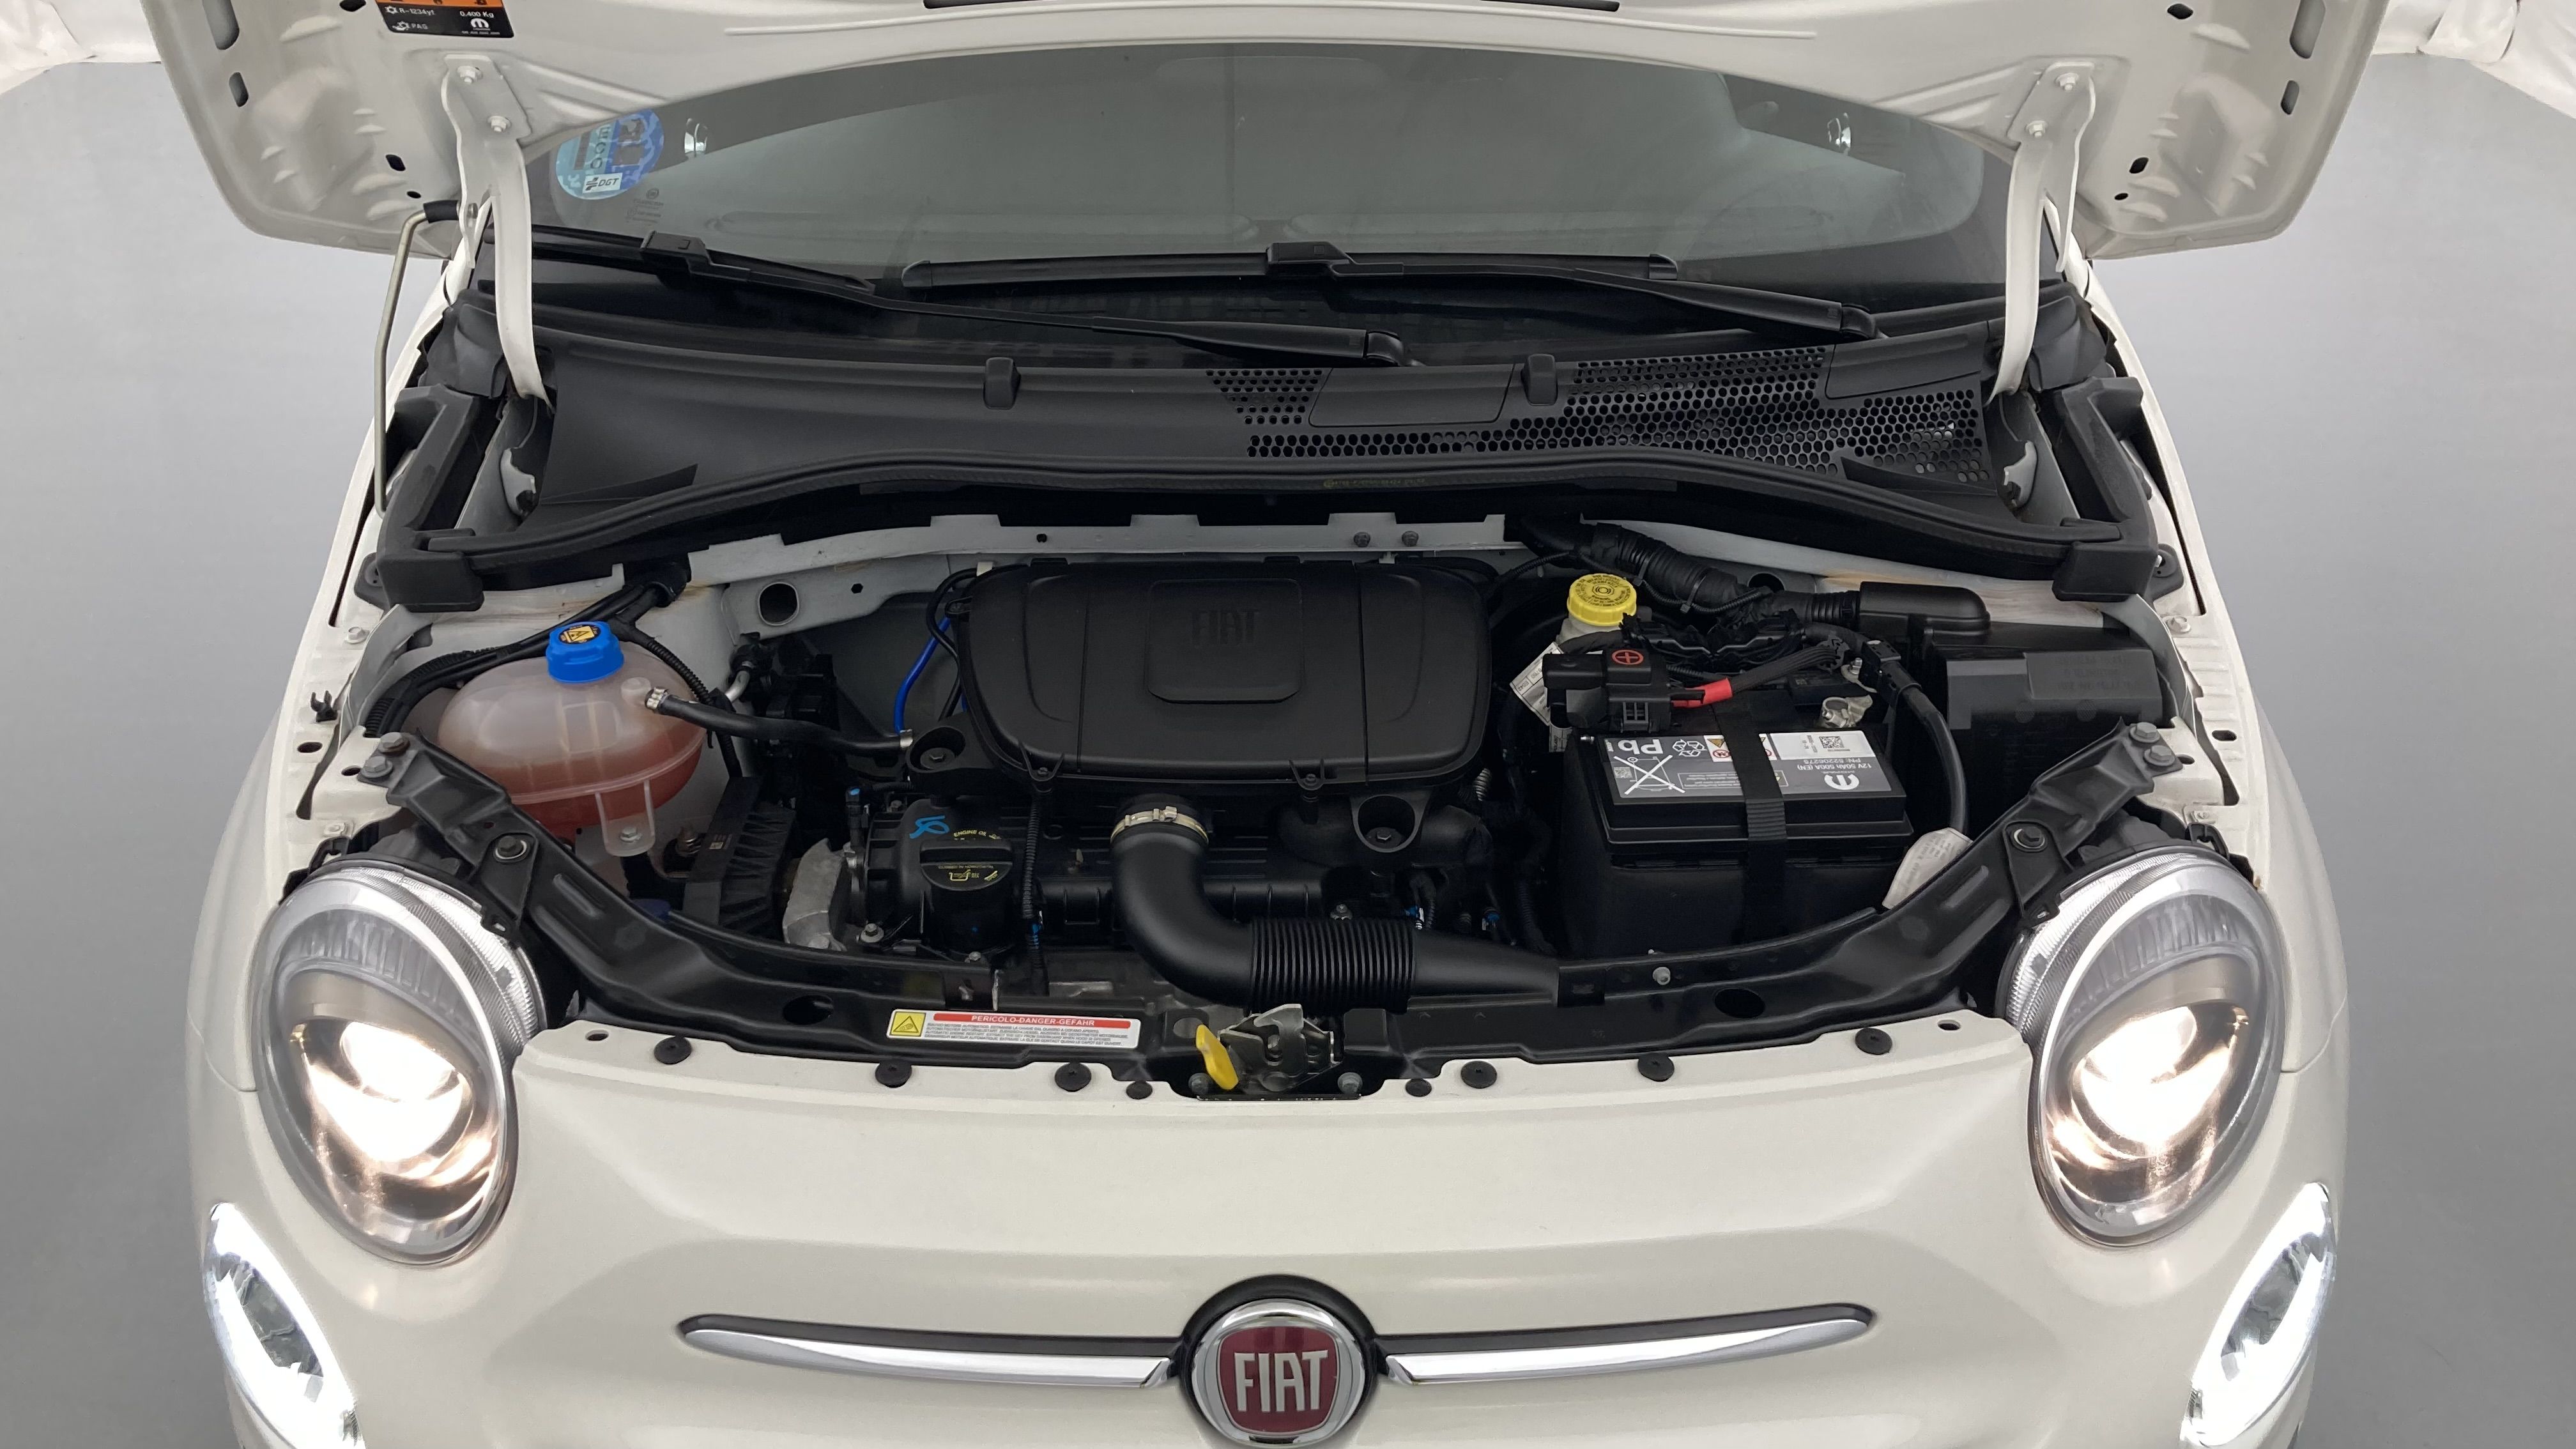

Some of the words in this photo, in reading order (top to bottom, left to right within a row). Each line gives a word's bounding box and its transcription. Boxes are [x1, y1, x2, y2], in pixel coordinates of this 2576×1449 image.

[598, 178, 620, 187] DGT
[1191, 609, 1260, 645] FIAT
[1618, 739, 1664, 755] Pb
[970, 1015, 1095, 1026] PERICOLO-DANGER-GEFAHR
[1234, 1350, 1328, 1412] FIAT
